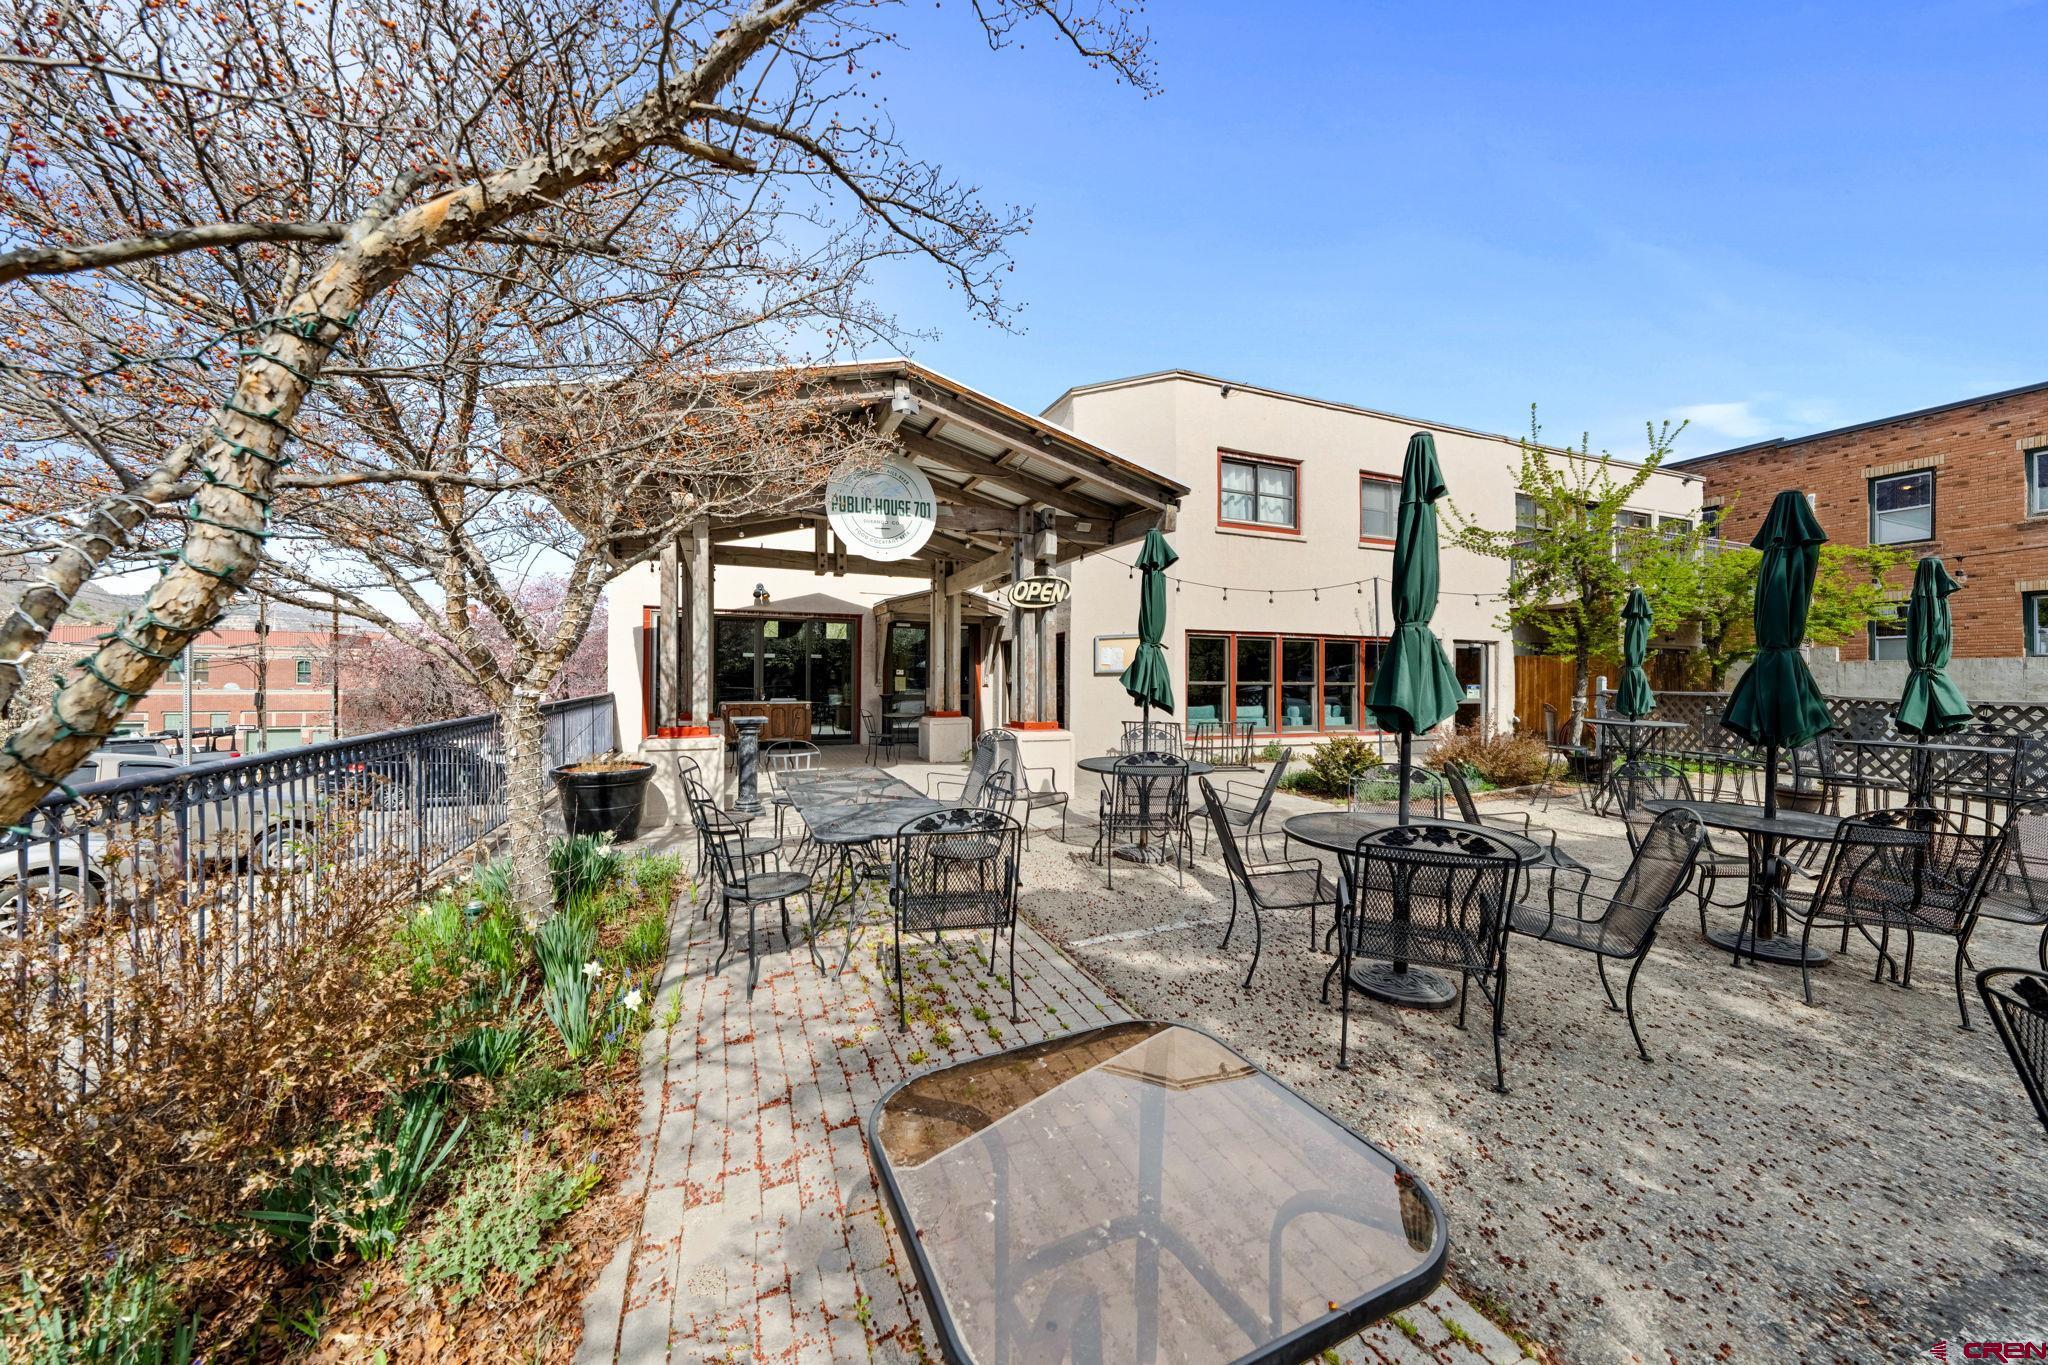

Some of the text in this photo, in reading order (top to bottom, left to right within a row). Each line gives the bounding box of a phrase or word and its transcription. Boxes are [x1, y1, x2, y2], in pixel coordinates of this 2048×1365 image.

[832, 495, 931, 518] PUBLIC HOUSE 701
[1013, 581, 1067, 603] OPEN
